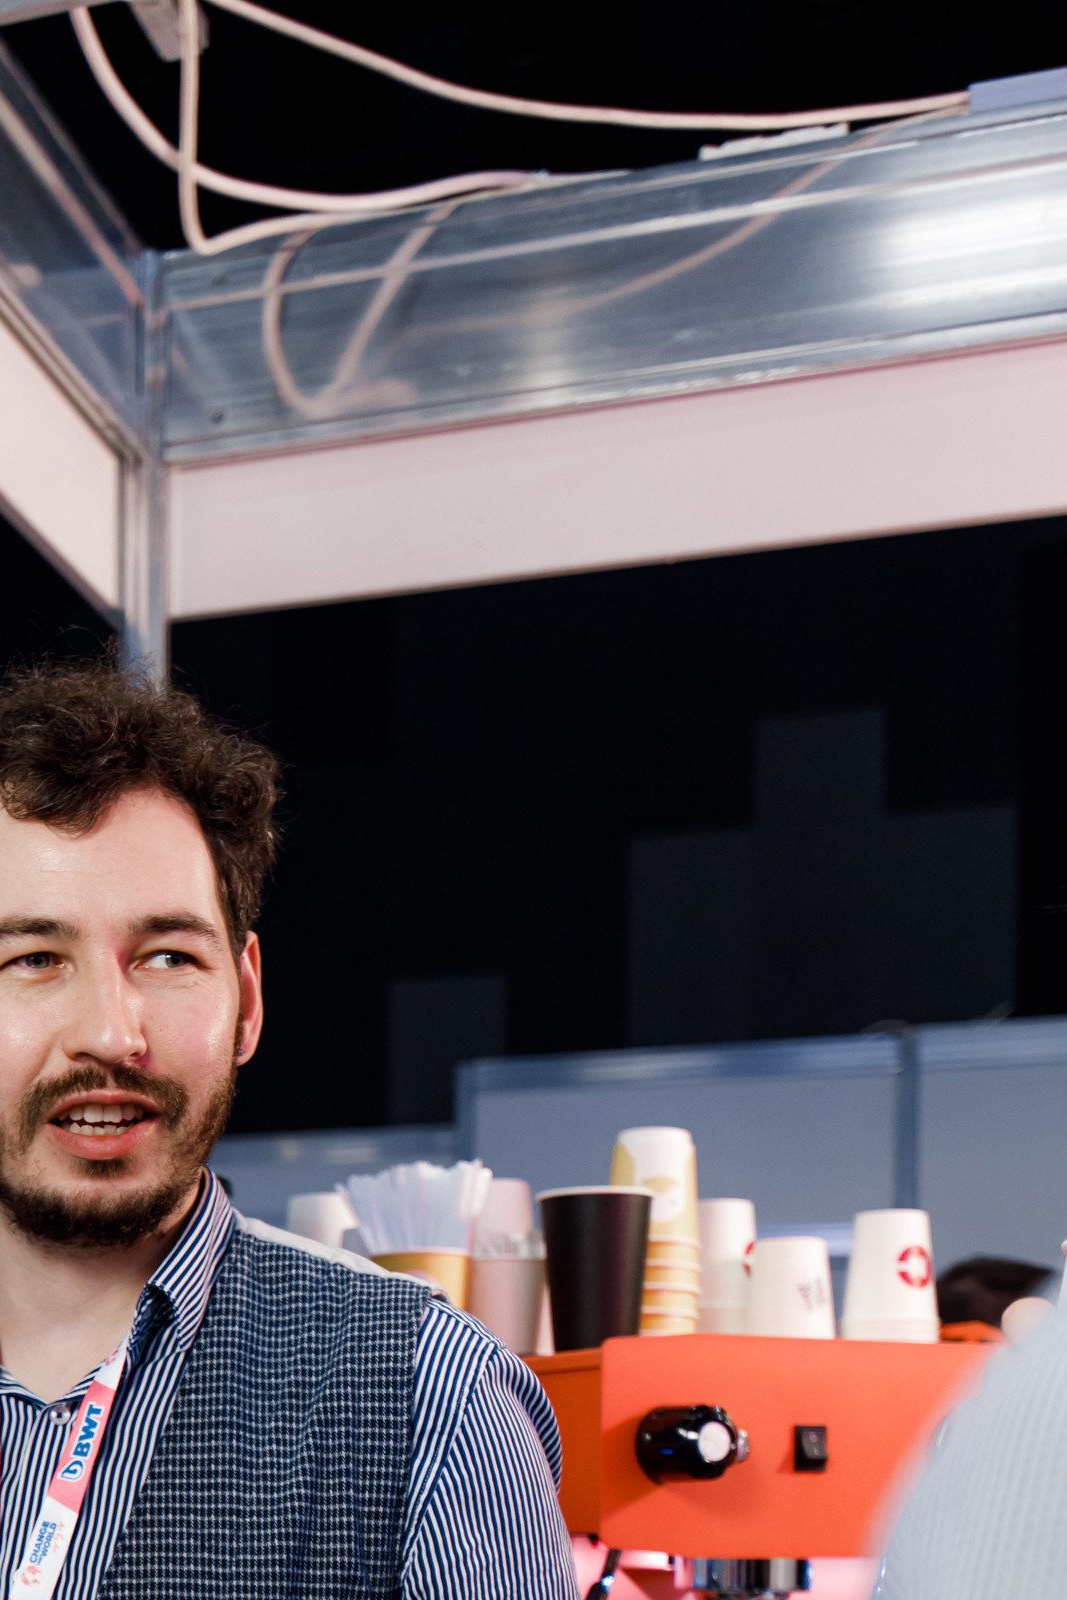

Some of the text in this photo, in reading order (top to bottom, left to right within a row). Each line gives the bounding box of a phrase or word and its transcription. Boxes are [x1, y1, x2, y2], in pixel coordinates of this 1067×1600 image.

[73, 1403, 102, 1458] BWT
[29, 1521, 50, 1563] CHANGE
[39, 1522, 58, 1559] WORLD
